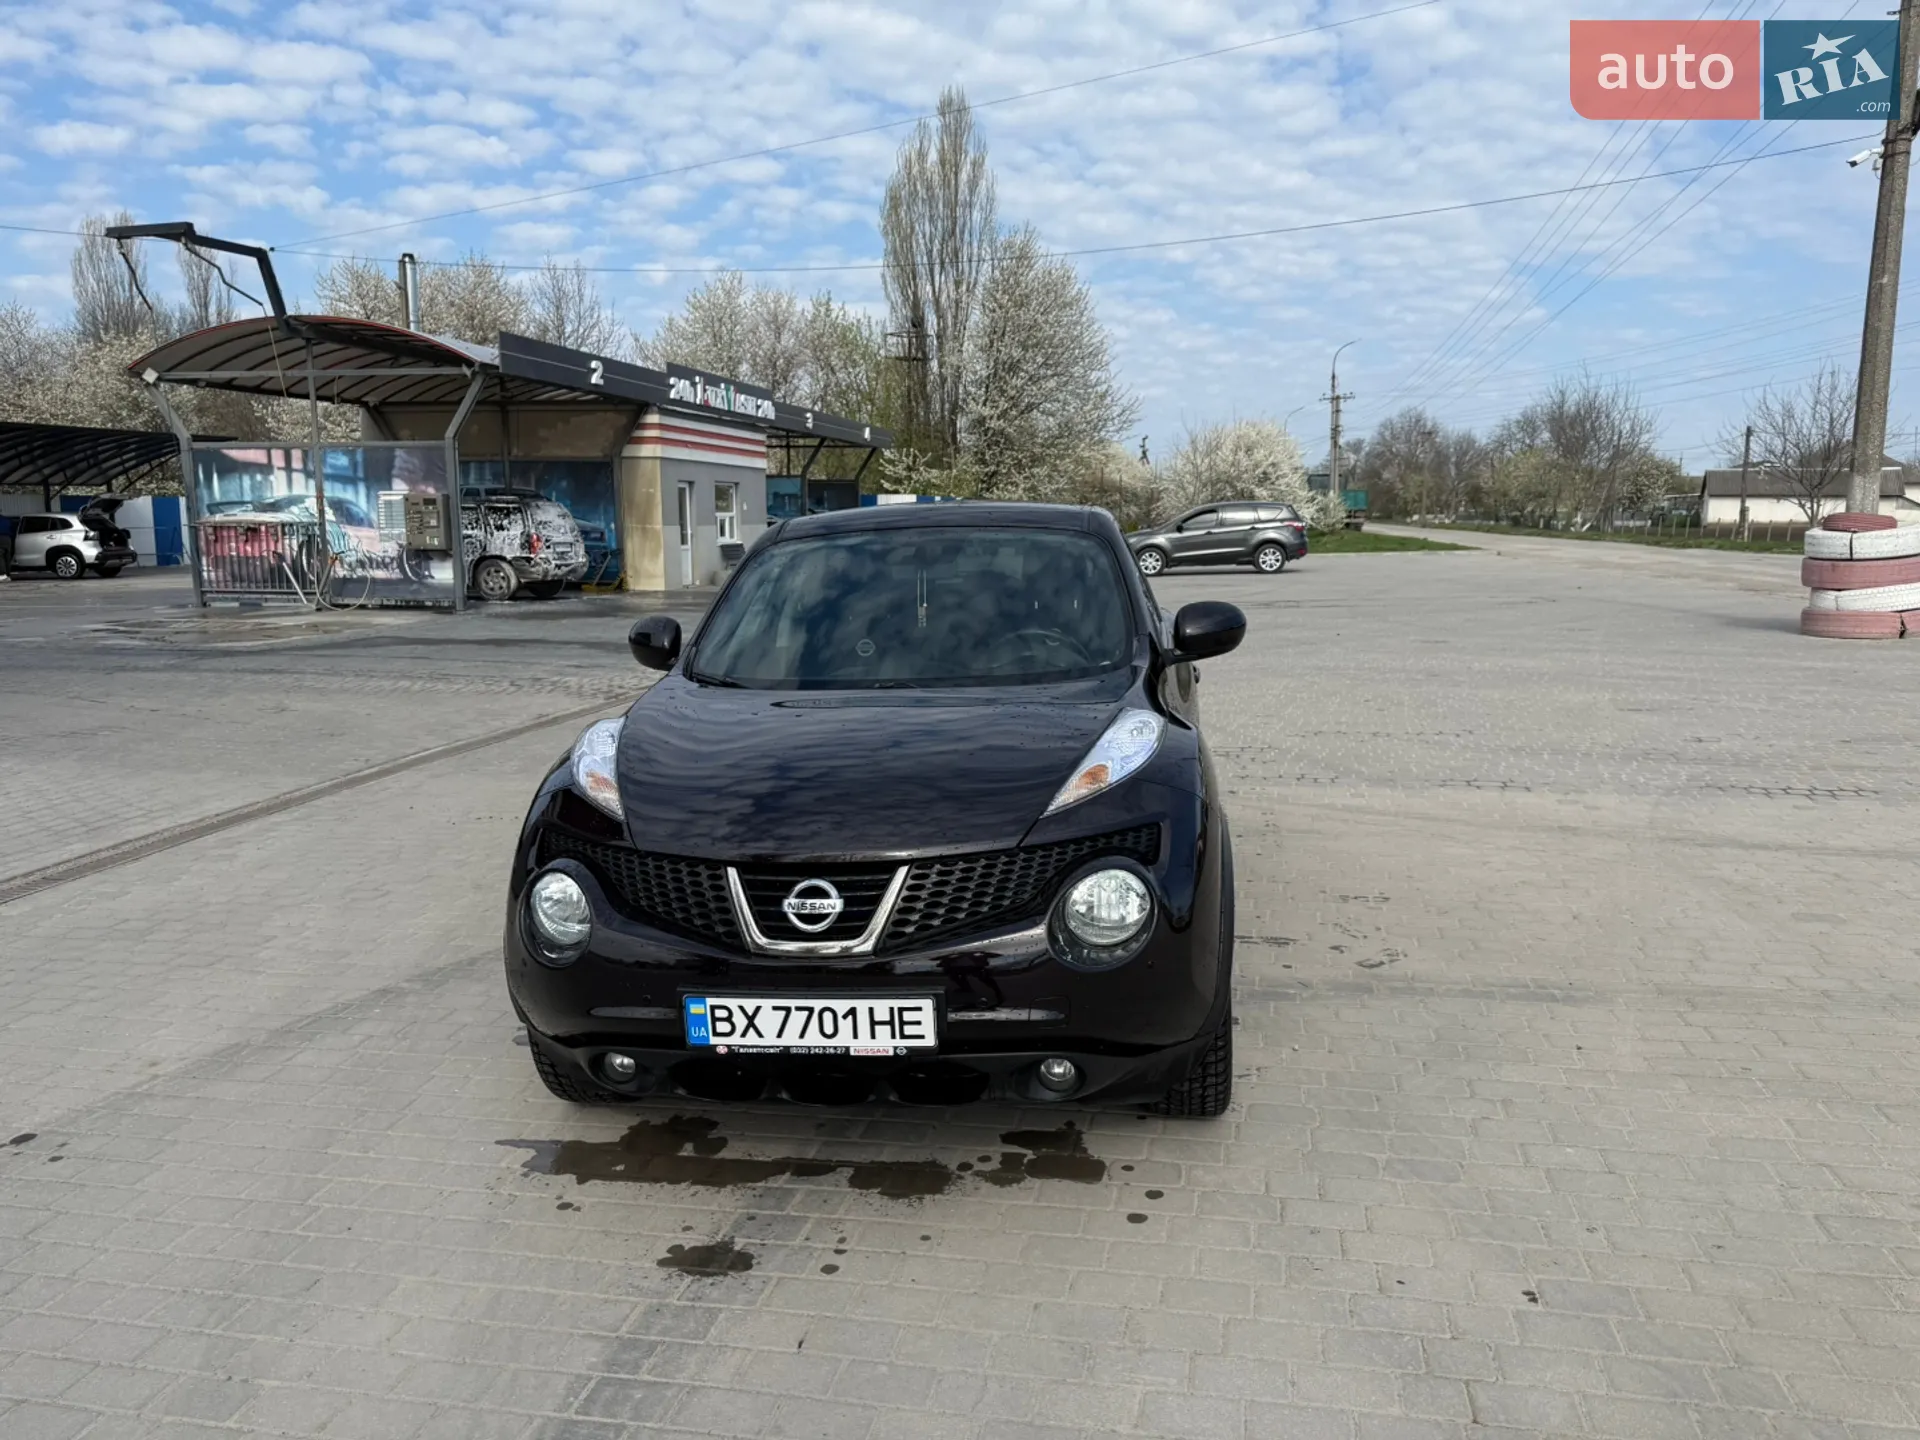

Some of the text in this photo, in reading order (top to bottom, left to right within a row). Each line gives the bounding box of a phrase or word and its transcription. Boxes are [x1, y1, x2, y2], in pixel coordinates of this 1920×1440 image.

[590, 360, 604, 385] 2
[787, 901, 837, 911] NISSAN
[691, 1027, 708, 1038] UA
